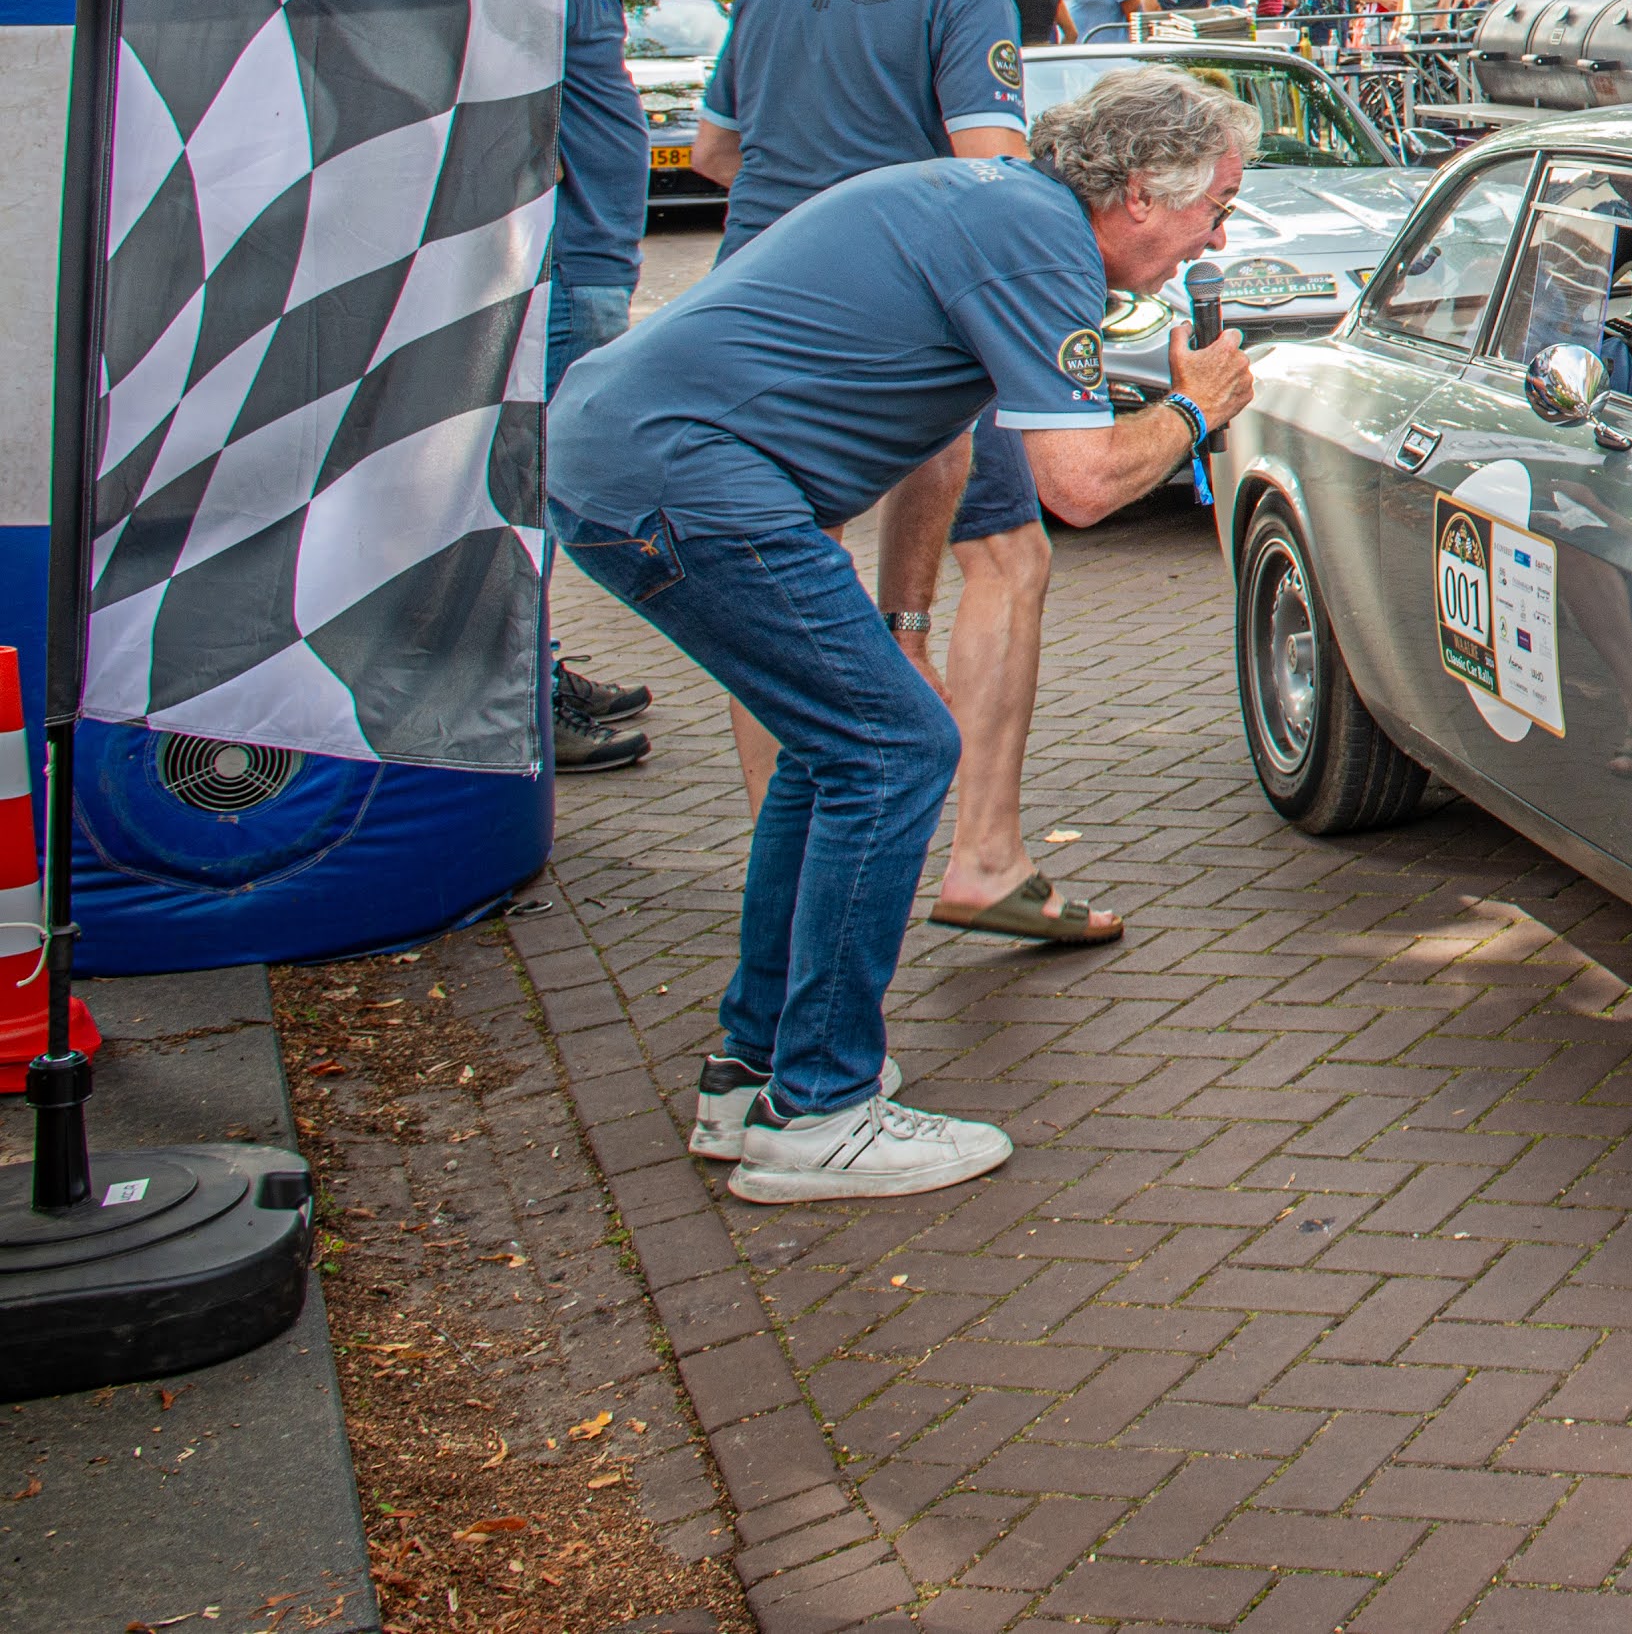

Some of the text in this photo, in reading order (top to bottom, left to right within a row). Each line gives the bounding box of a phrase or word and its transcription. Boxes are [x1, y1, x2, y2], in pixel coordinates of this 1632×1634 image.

[650, 149, 692, 165] 58-
[1228, 276, 1294, 288] WAALRE
[1221, 283, 1326, 298] assic Car Rally
[1445, 565, 1485, 635] 001
[1445, 648, 1467, 671] Classic
[1466, 659, 1478, 678] Car
[1477, 665, 1494, 691] Rally
